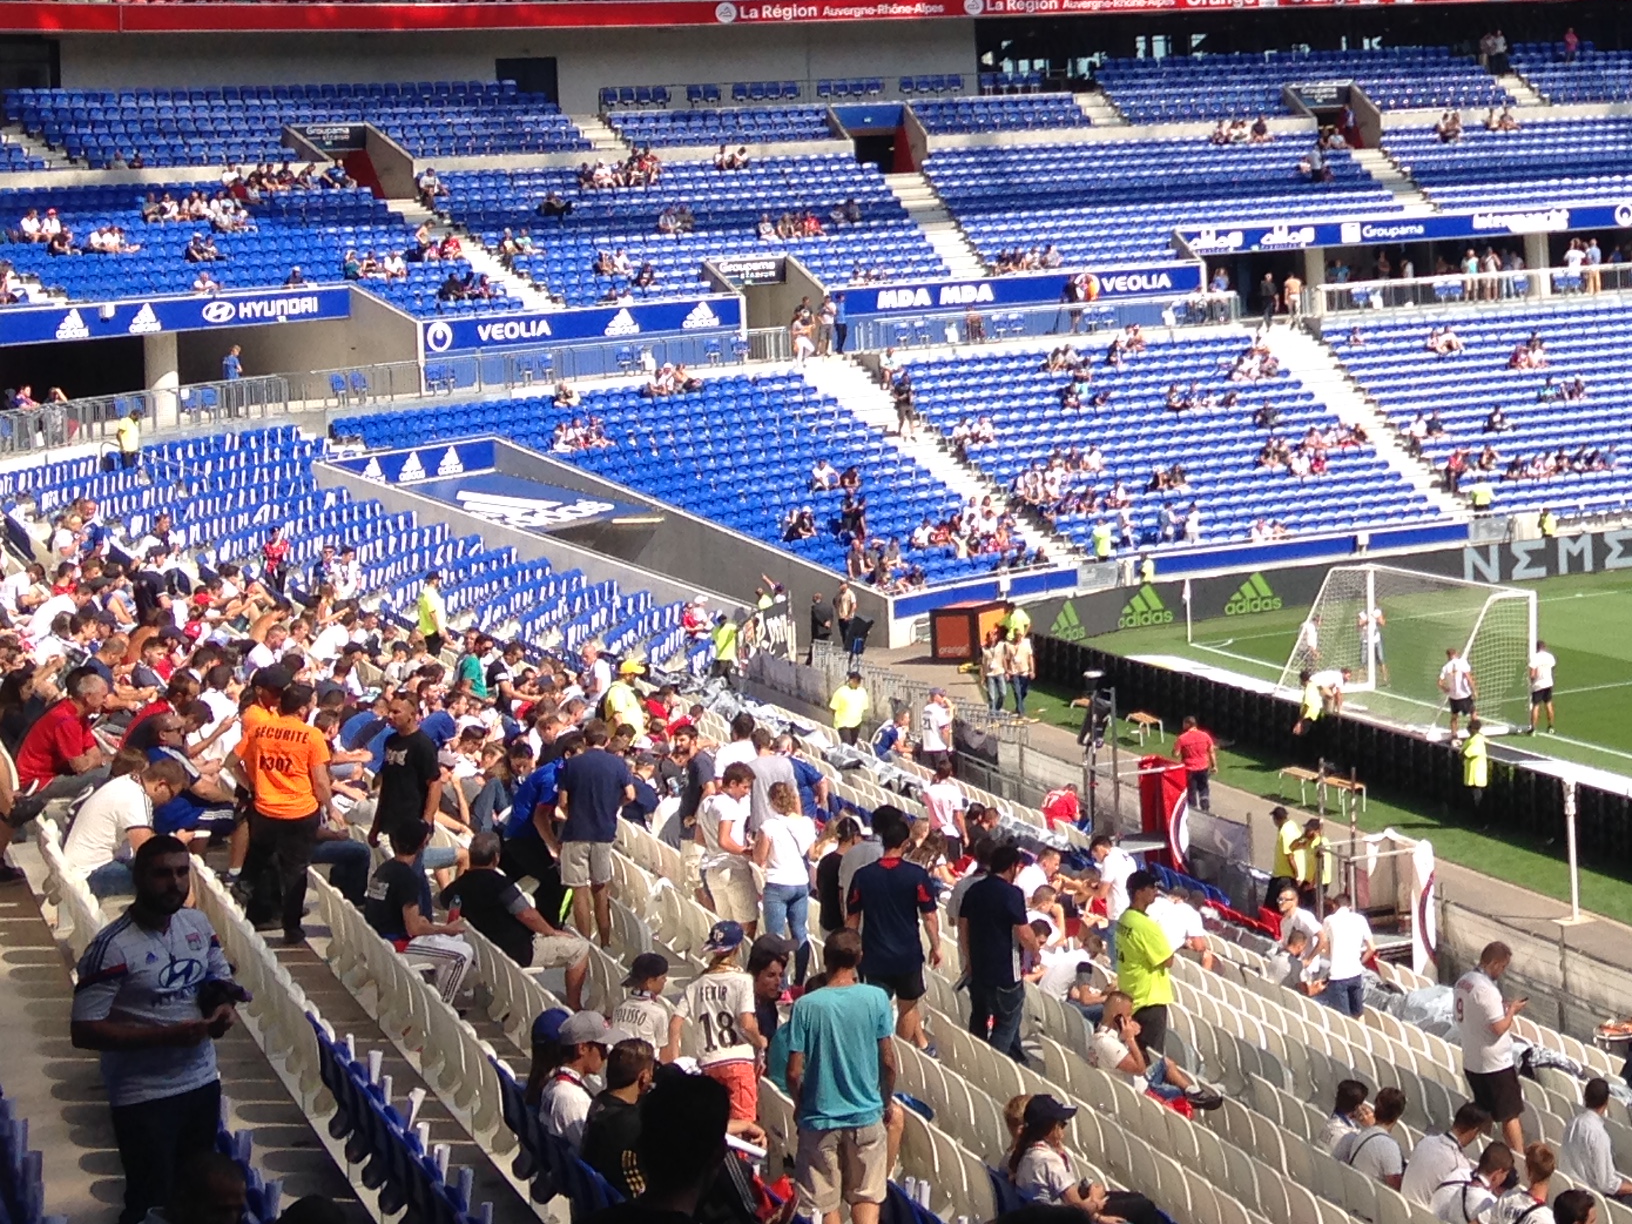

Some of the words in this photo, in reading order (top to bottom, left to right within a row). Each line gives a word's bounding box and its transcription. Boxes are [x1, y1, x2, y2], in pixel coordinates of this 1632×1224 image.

[740, 7, 758, 18] La
[762, 3, 817, 21] Région
[986, 0, 1004, 11] La
[1362, 223, 1424, 238] Groupama
[1102, 272, 1171, 292] VEOLIA
[877, 290, 931, 309] MDA
[939, 284, 994, 303] MDA
[239, 296, 318, 319] HYUNDAI
[478, 320, 551, 342] VEOLIA
[1225, 595, 1282, 615] adidas
[1118, 609, 1173, 628] adidas
[255, 725, 309, 745] SÉCURITÉ
[699, 1010, 738, 1052] 18
